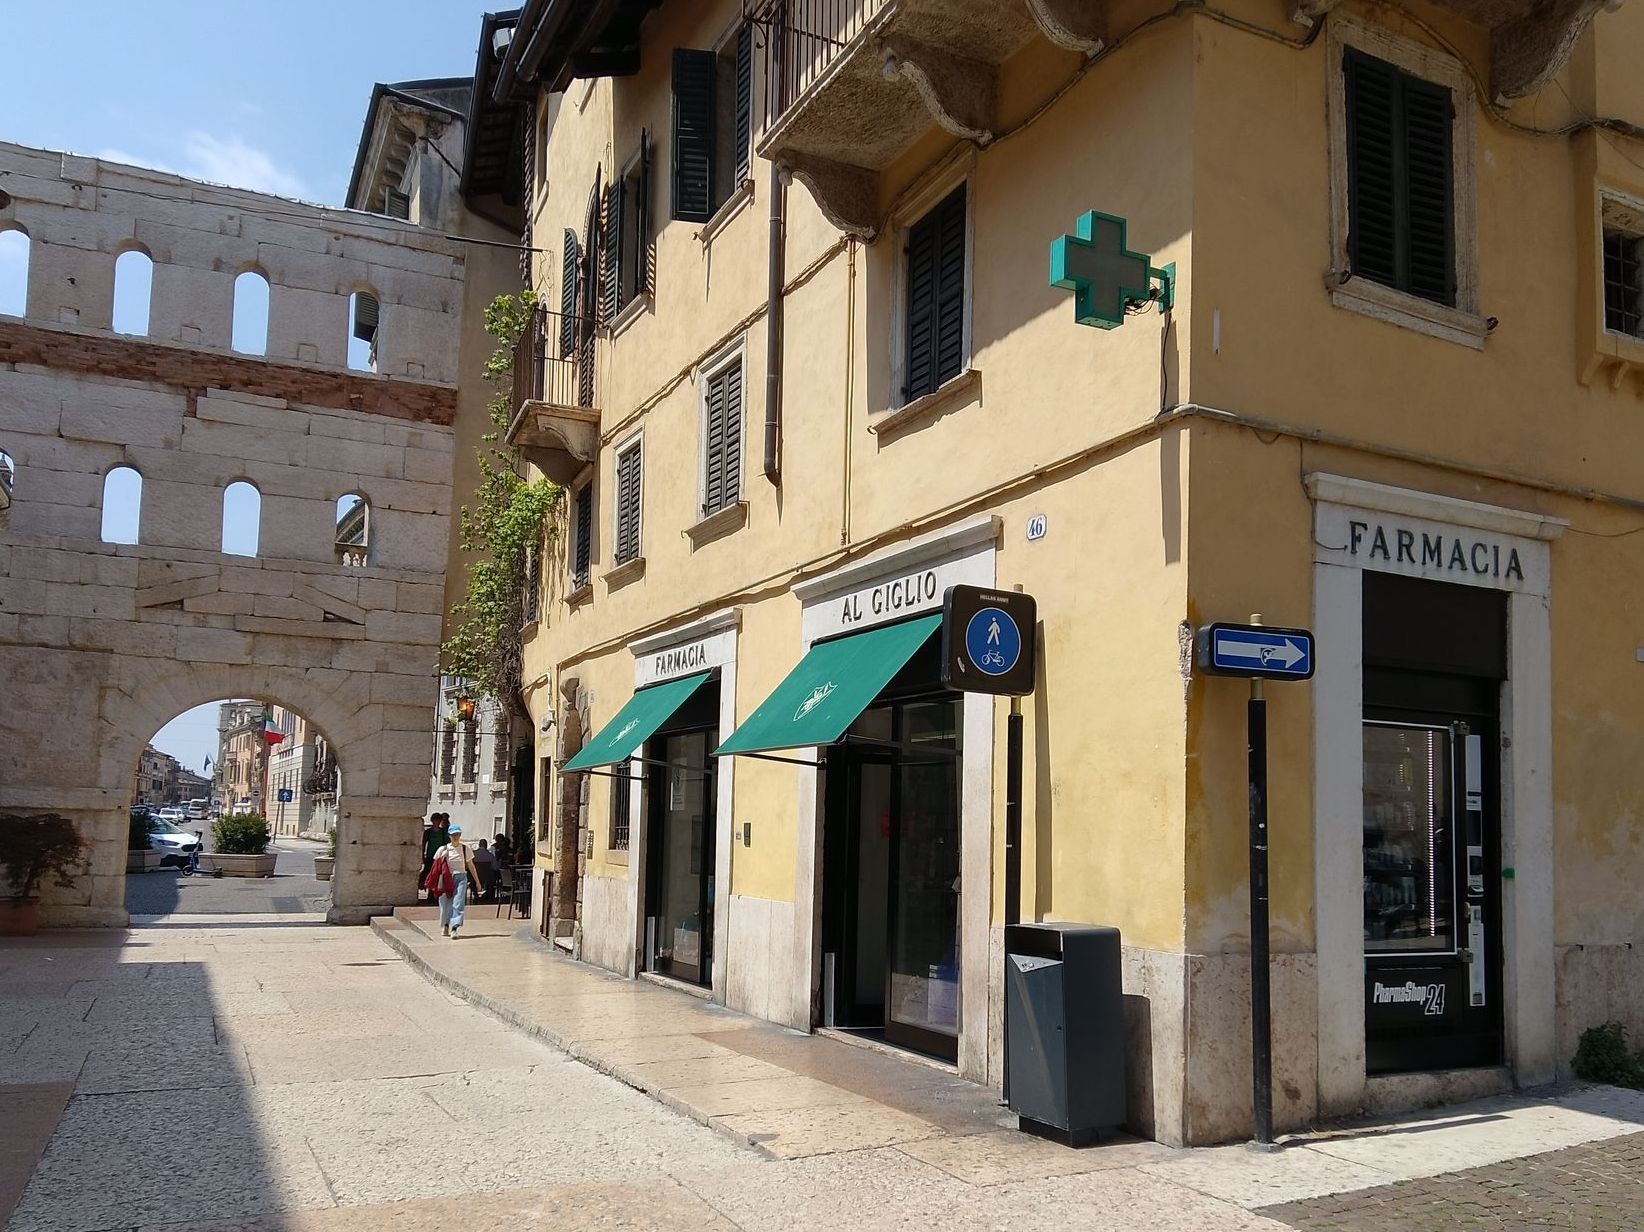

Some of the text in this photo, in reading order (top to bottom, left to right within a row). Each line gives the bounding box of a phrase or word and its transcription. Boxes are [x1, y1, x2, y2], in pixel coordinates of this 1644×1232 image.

[1029, 517, 1043, 537] 46
[1349, 520, 1524, 581] FARMACIA
[842, 571, 937, 625] AL GIGLIO
[655, 643, 707, 676] FARMACIA
